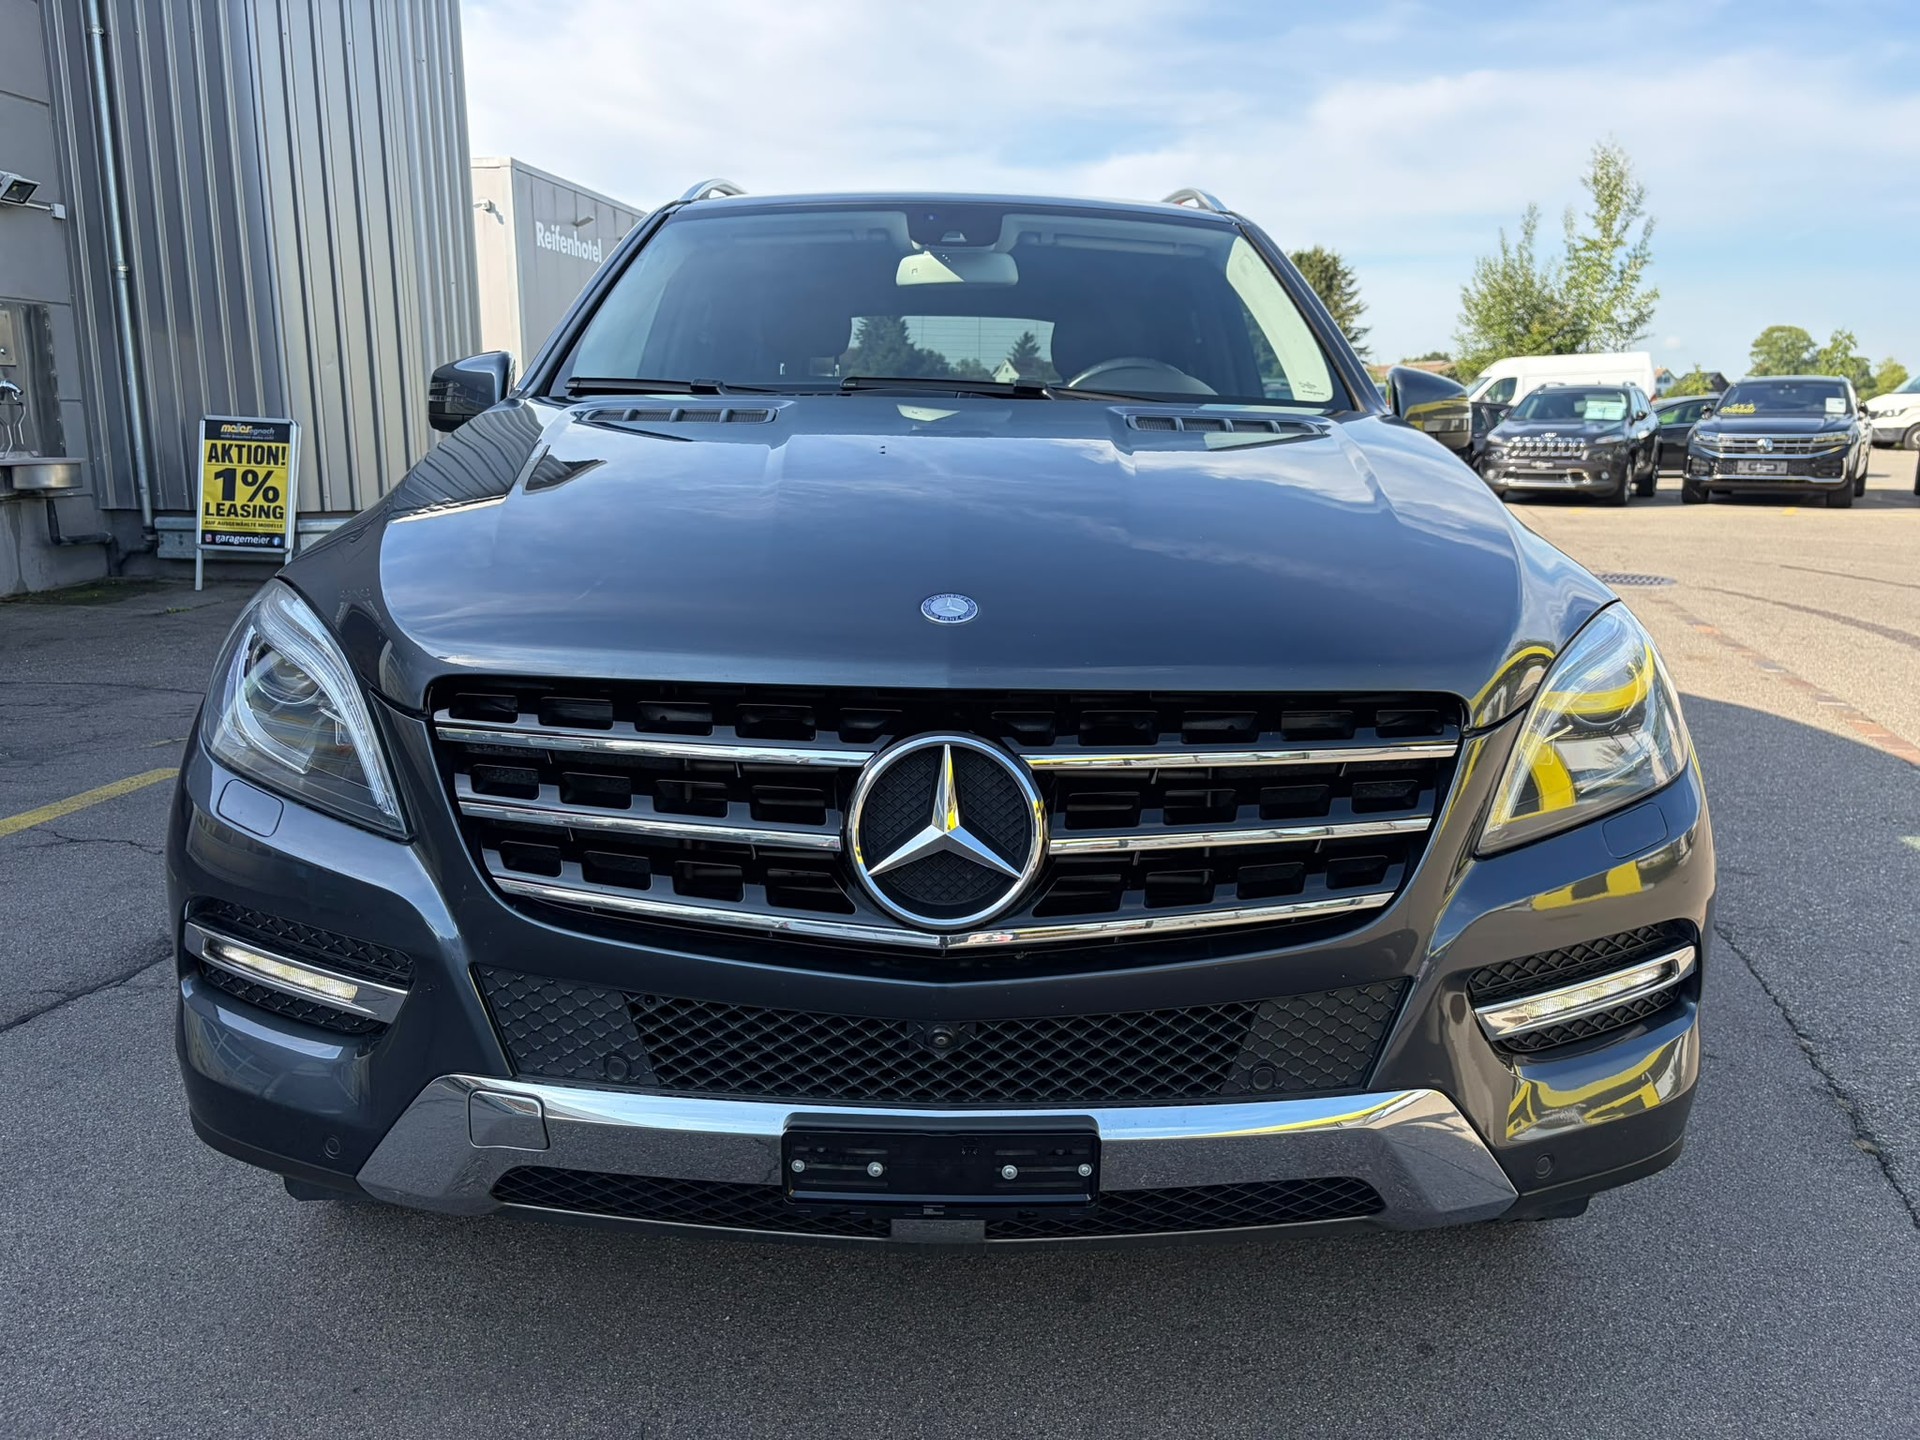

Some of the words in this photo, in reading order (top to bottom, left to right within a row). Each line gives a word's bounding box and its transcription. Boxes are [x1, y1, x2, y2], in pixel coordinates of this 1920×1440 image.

[536, 220, 602, 263] Reifenhotel
[207, 443, 287, 466] AKTION!
[214, 468, 280, 504] 1%
[205, 502, 284, 520] LEASING
[215, 534, 271, 545] garagemeier
